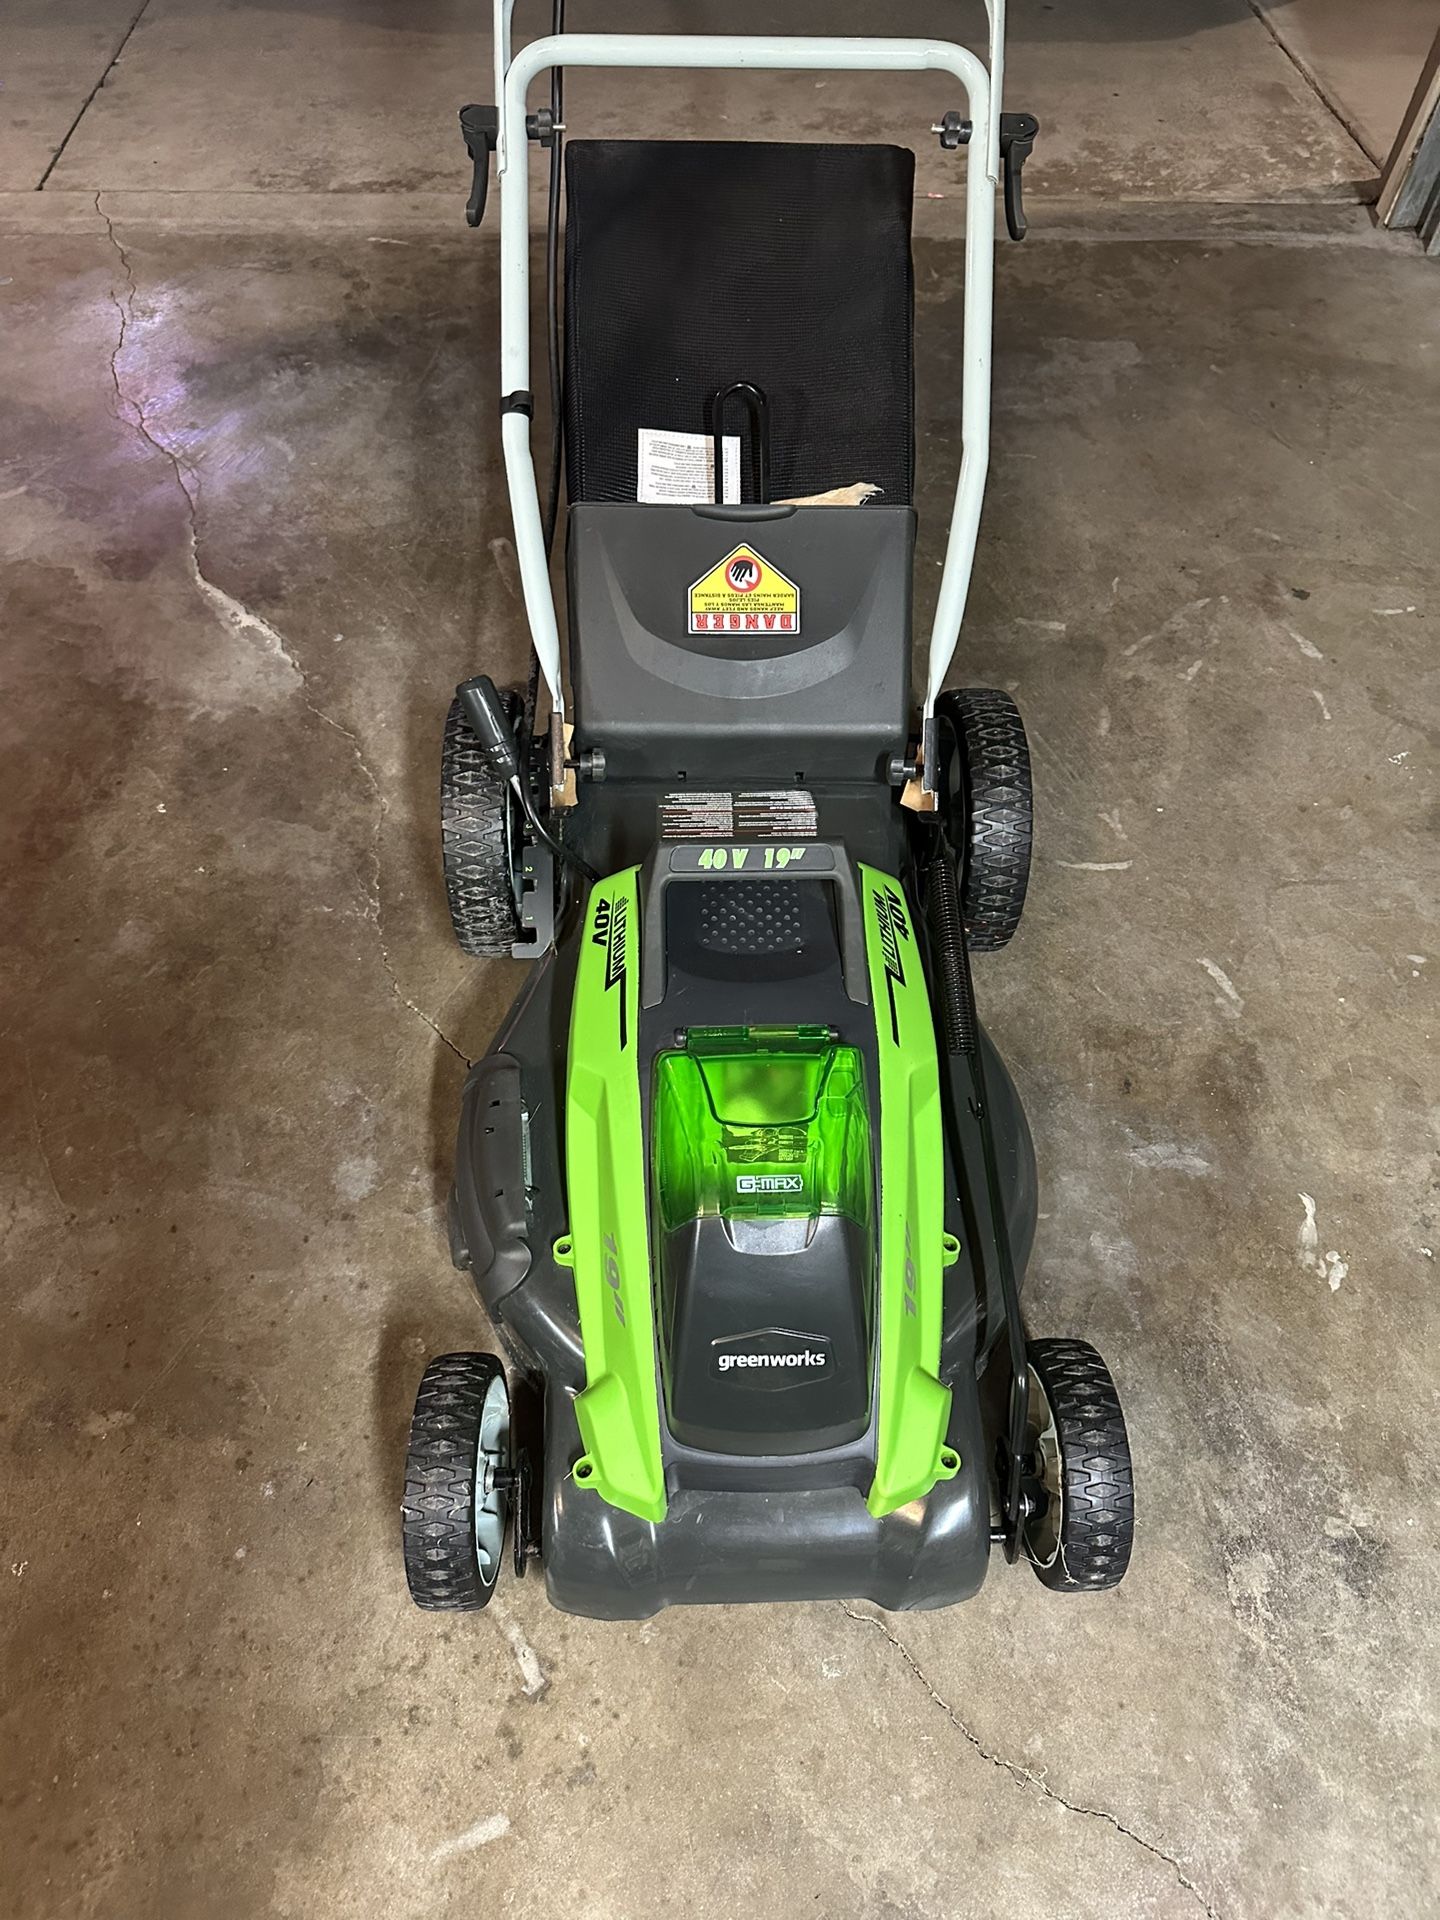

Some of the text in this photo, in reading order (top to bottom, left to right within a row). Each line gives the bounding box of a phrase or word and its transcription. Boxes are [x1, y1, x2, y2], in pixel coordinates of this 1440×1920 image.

[695, 614, 792, 629] DANGER
[592, 898, 610, 946] 40V
[872, 889, 896, 961] LITHIUM
[884, 883, 910, 942] 40V
[612, 906, 627, 977] LITHIUM
[718, 1349, 826, 1371] greenworks
